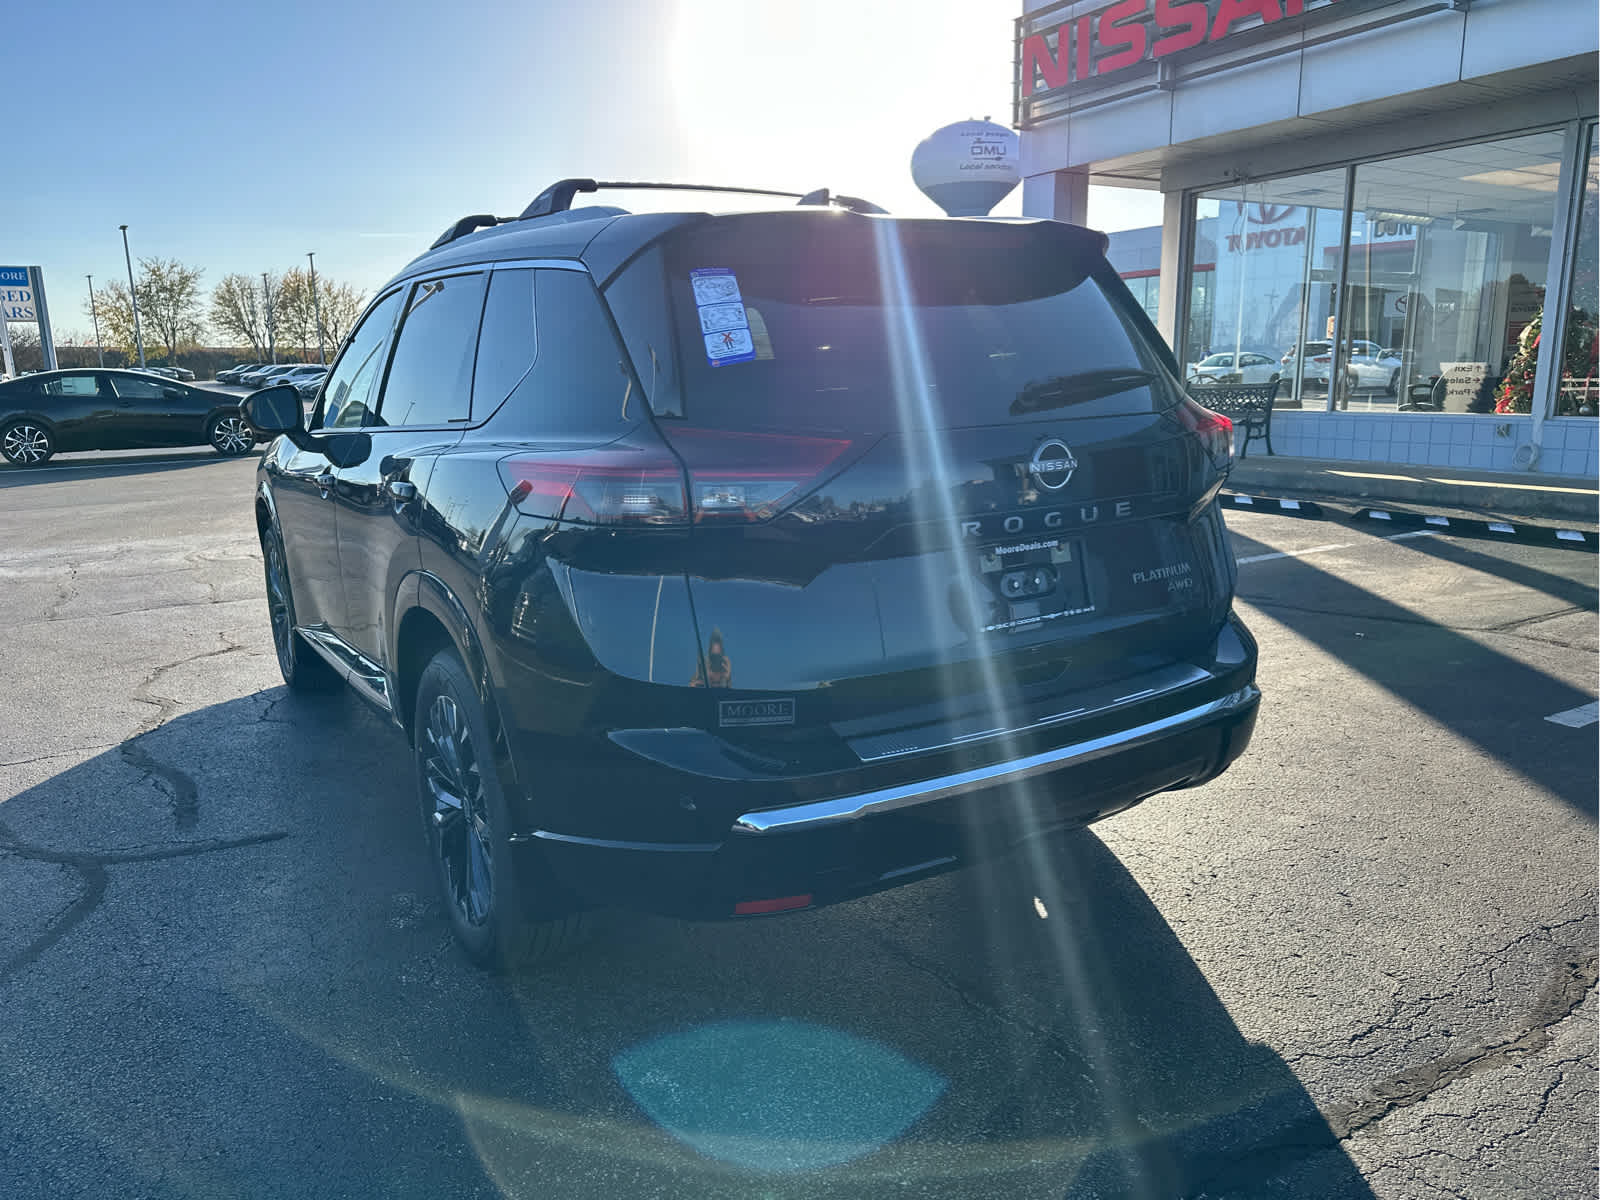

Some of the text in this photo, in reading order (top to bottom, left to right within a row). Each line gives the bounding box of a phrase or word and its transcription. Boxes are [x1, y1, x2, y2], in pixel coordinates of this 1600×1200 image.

[1022, 0, 1304, 97] NISSA
[0, 272, 26, 280] ORE
[1029, 459, 1078, 473] NISSAN
[961, 501, 1132, 538] ROGUE
[995, 539, 1059, 556] MooreDeals.com
[1132, 562, 1191, 584] PLATINUM
[1167, 577, 1193, 593] AWD
[727, 703, 788, 716] MOORE
